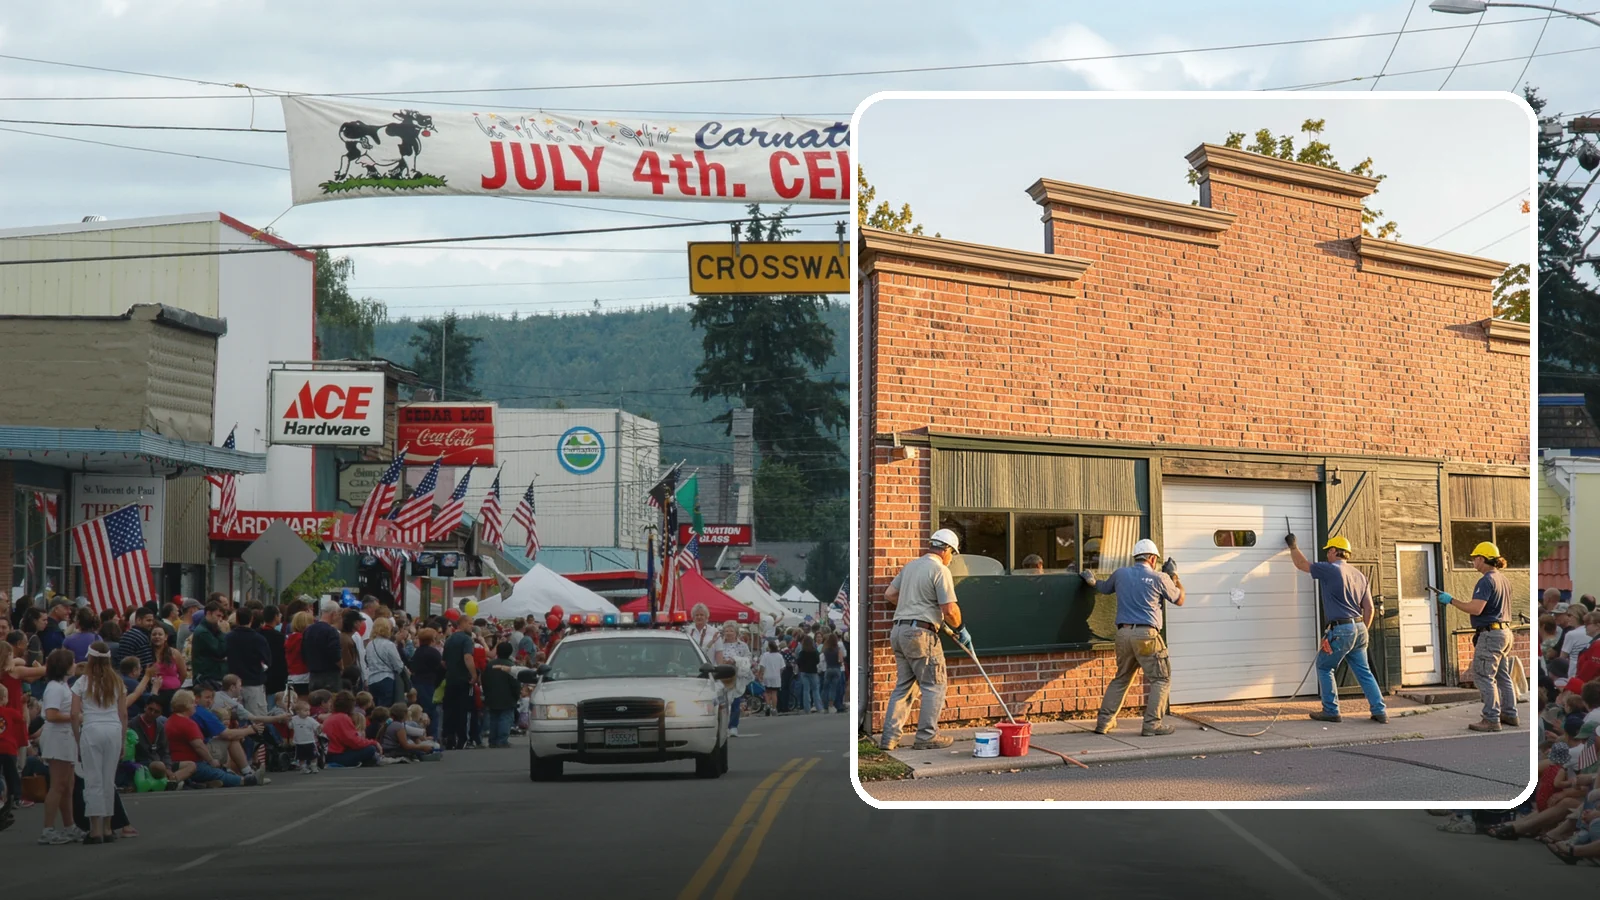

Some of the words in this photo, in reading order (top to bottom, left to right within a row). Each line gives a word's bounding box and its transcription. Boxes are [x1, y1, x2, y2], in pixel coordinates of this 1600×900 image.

[480, 141, 605, 192] JULY
[632, 150, 747, 198] 4th.
[696, 254, 850, 280] CROSSWA
[282, 379, 373, 420] ACE
[406, 409, 452, 422] CEDAR
[283, 420, 371, 436] Hardware
[353, 467, 385, 480] Simpl
[83, 485, 93, 494] St.
[95, 484, 124, 494] Vincent
[126, 486, 136, 495] de
[137, 486, 155, 496] Paul
[212, 515, 331, 536] HARDARE
[688, 526, 741, 535] CRNATION
[699, 535, 730, 543] GLASS
